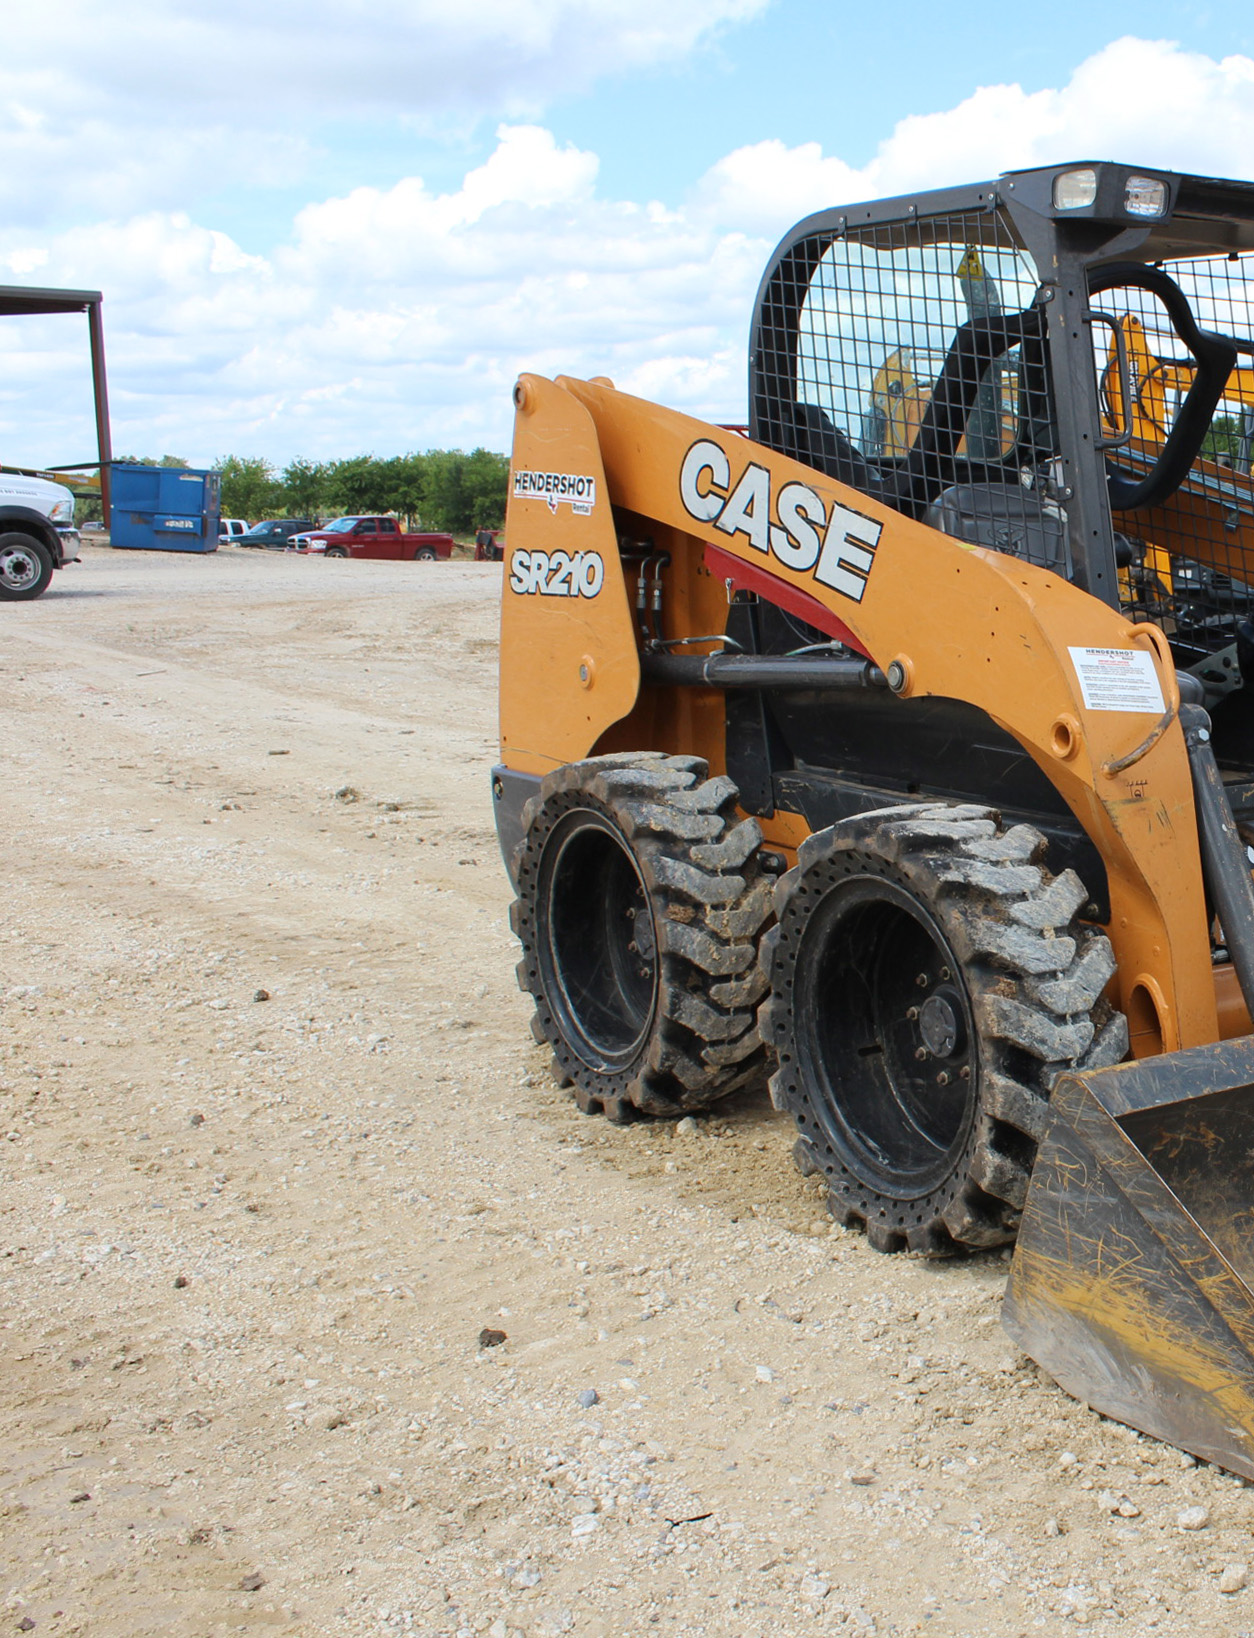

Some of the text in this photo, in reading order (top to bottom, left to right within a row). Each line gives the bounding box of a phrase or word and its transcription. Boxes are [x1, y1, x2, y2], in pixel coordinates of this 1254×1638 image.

[515, 472, 594, 497] HENDERSHOT
[679, 438, 884, 604] CASE
[509, 548, 604, 599] SR210
